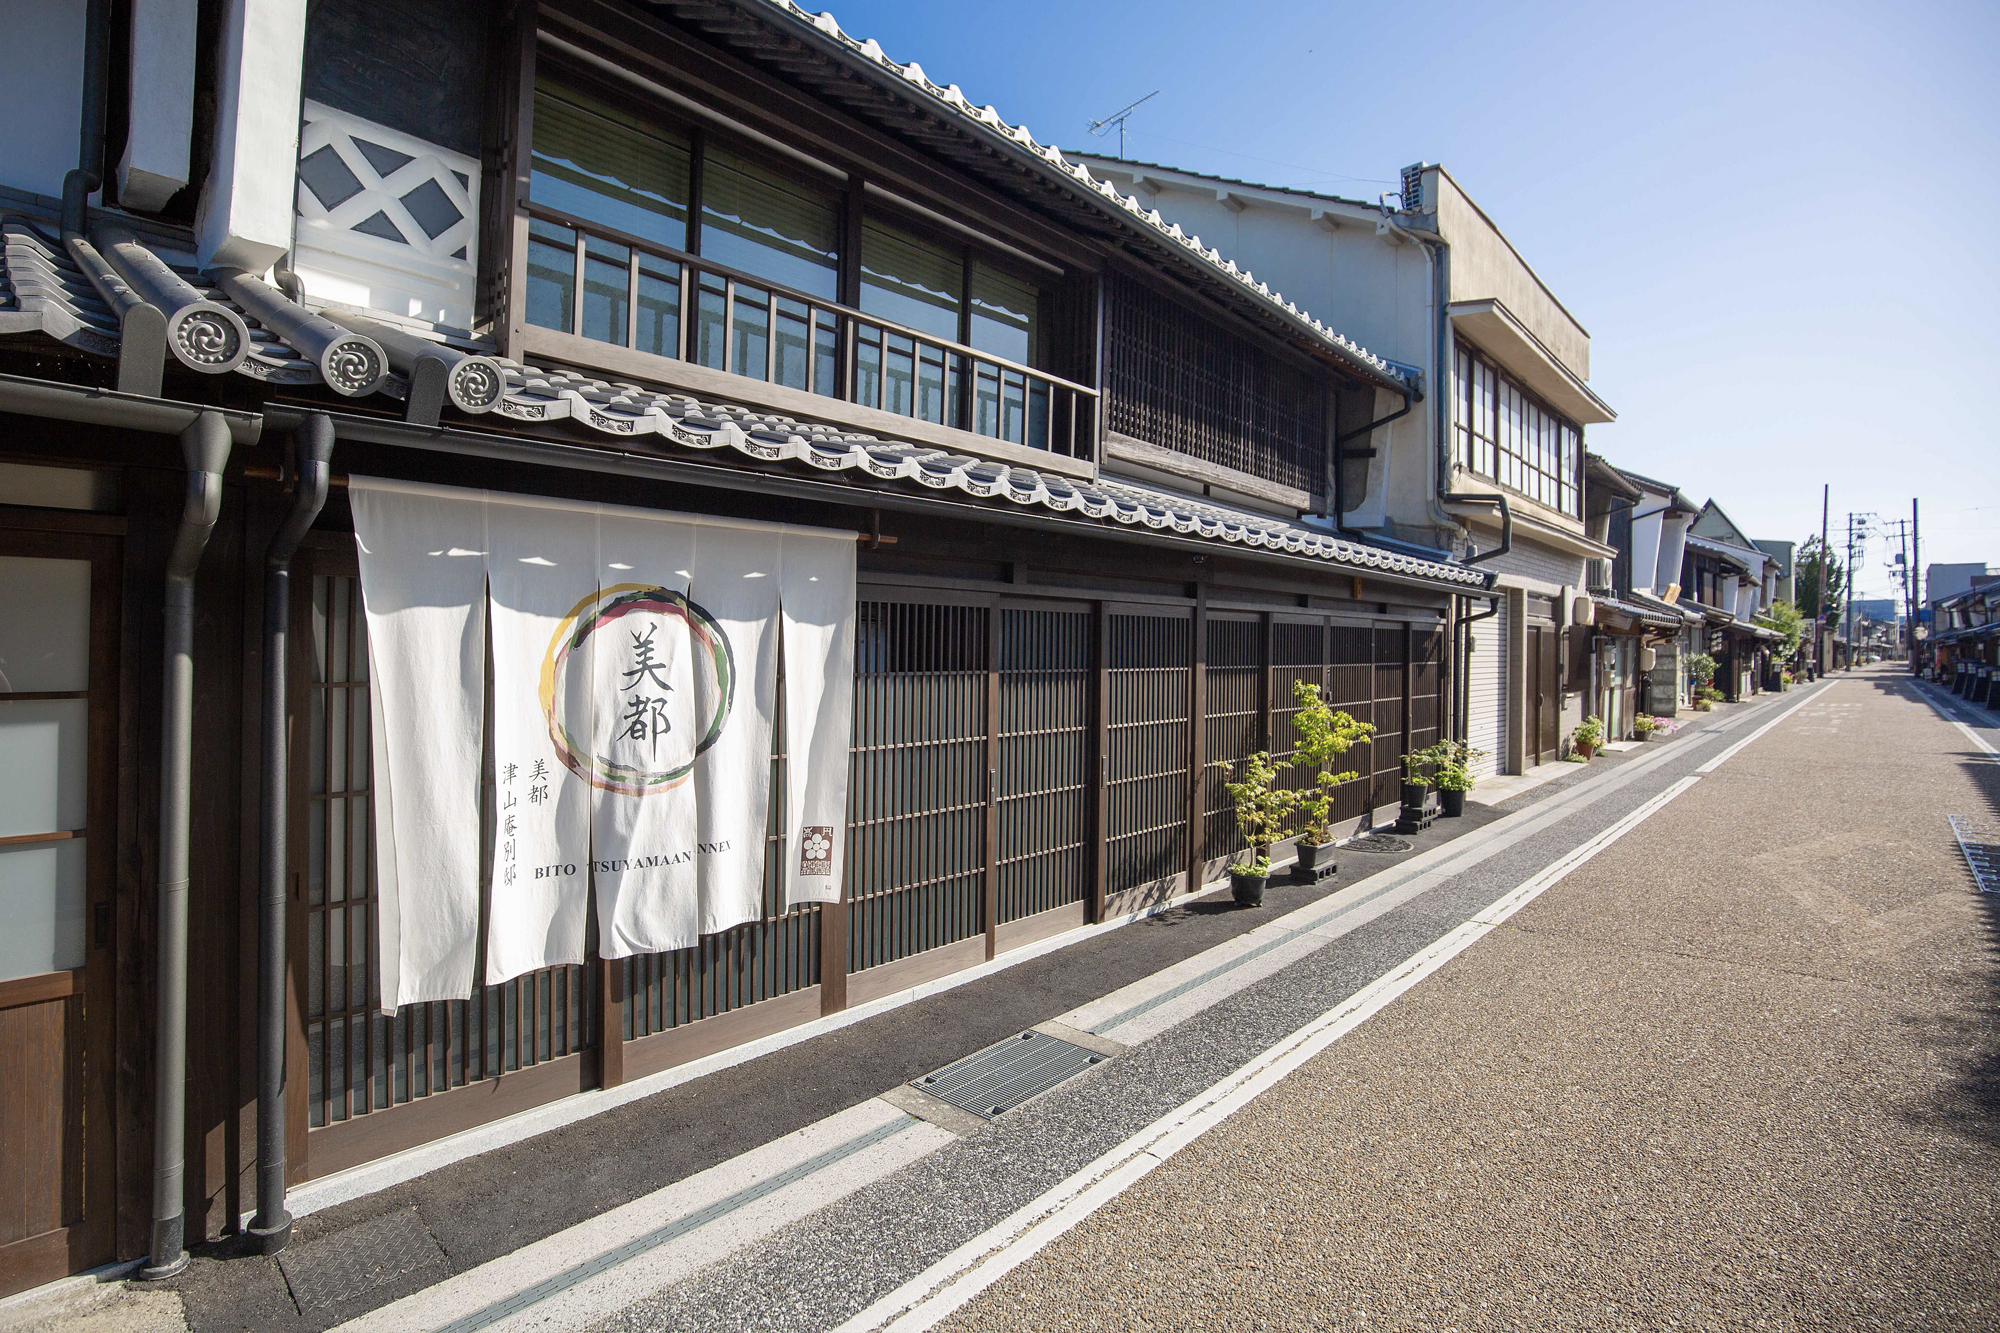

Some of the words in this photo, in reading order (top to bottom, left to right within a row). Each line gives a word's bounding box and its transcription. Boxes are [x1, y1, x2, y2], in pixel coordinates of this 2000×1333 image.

[616, 622, 674, 762] 美都
[502, 762, 519, 886] 津山庵別邸
[527, 758, 549, 806] 美都
[534, 863, 577, 880] BITO
[588, 851, 692, 873] TSUYAMAAN
[695, 839, 731, 854] NNEX
